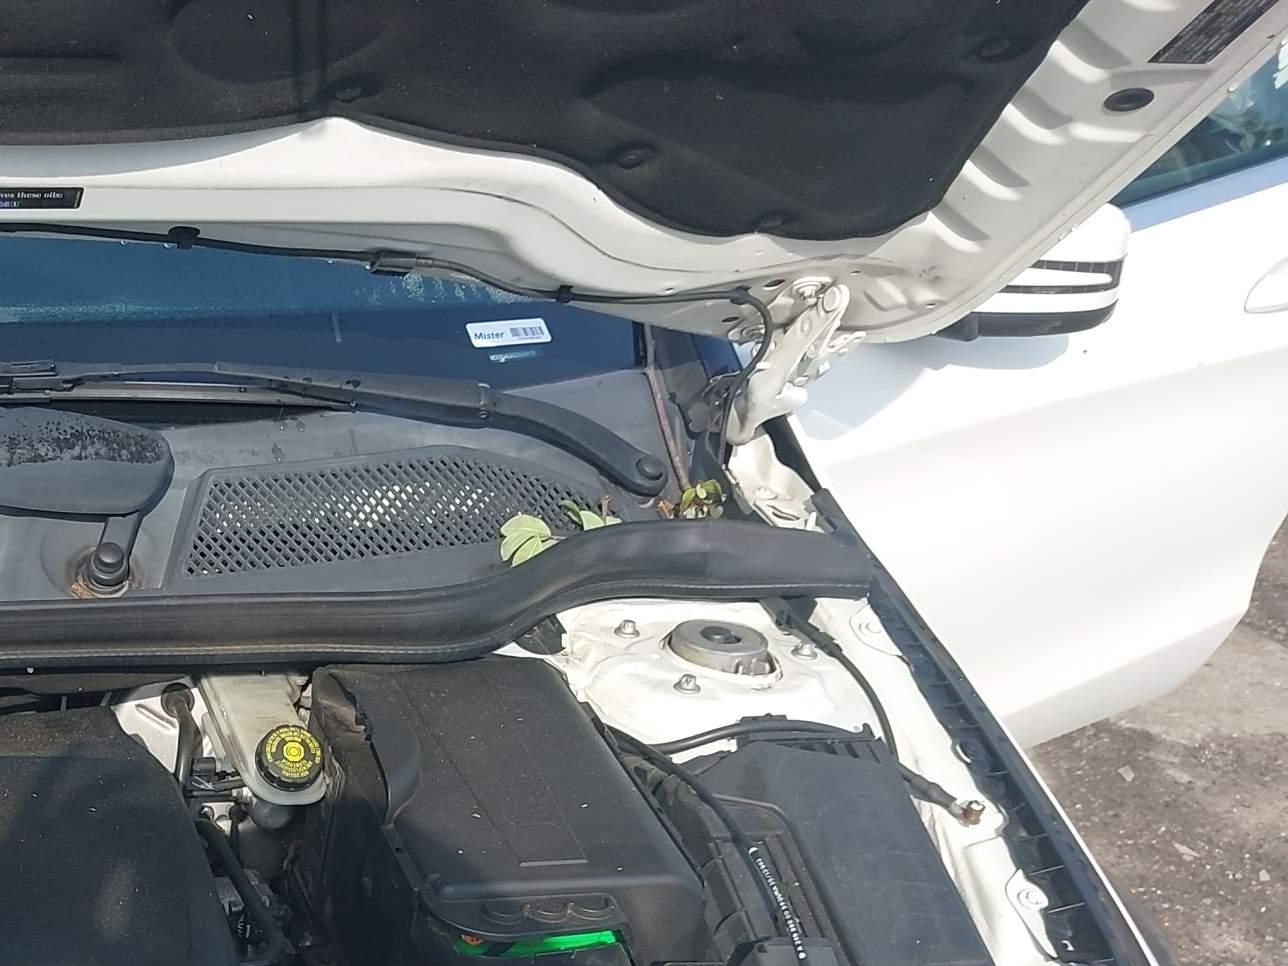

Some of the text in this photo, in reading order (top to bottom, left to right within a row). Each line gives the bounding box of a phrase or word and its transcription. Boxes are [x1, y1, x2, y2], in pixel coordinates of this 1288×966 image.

[16, 191, 42, 199] these
[43, 191, 64, 199] oils:
[474, 331, 504, 340] Mister
